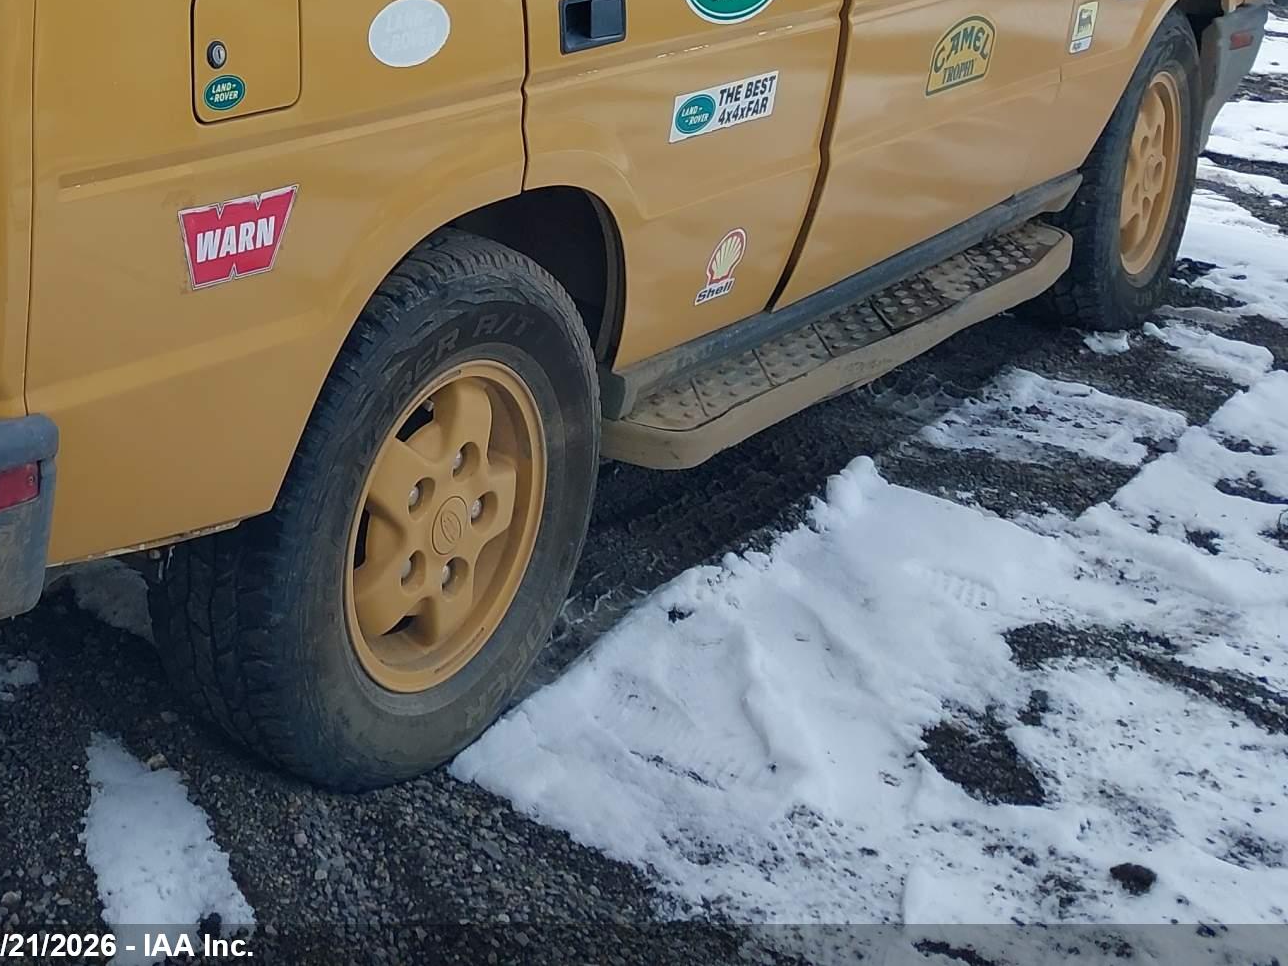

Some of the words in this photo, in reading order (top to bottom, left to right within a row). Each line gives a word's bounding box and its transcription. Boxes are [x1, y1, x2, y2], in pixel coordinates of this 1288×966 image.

[934, 26, 990, 73] CAMEL
[212, 82, 232, 94] LAND
[214, 90, 239, 103] ROVER
[719, 83, 743, 106] THE
[745, 75, 776, 99] BEST
[681, 105, 699, 117] LAND
[688, 113, 710, 126] ROVER
[718, 96, 768, 125] 4x4xFAR
[196, 215, 275, 263] WARN
[697, 280, 733, 302] Shell
